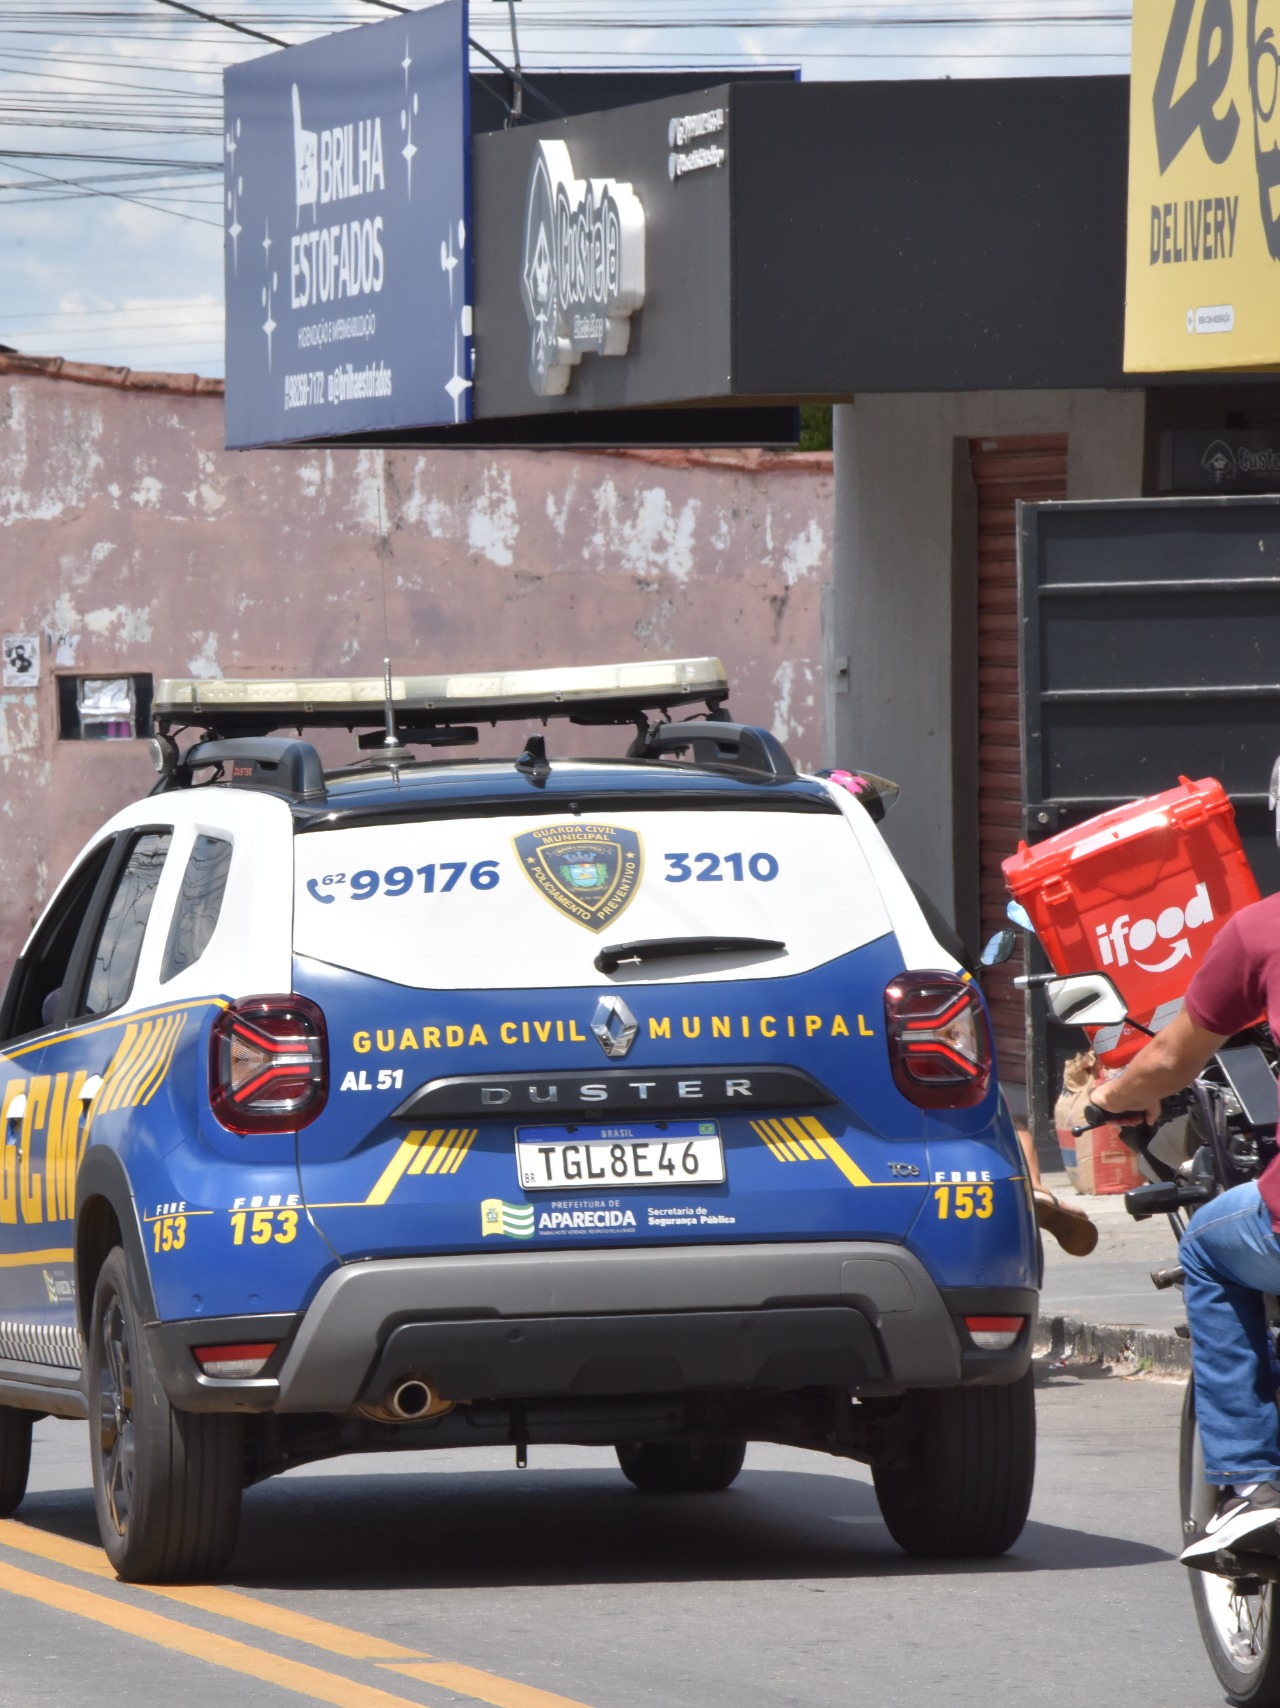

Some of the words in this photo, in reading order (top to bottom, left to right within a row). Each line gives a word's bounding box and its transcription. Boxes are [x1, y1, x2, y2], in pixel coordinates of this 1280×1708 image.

[321, 117, 385, 204] BRILHA
[1150, 195, 1239, 266] DELIVERY
[291, 216, 384, 309] ESTOFADOS
[532, 826, 582, 838] GUARDA
[585, 826, 616, 835] CIVIL
[542, 833, 610, 844] MUNICIPAL
[321, 873, 346, 885] 62
[349, 860, 500, 901] 99176
[664, 851, 779, 884] 3210
[531, 866, 591, 920] POLICIAMENTO
[597, 861, 636, 920] PREVENTIVO
[1095, 882, 1214, 967] ifood
[353, 1024, 488, 1054] GUARDA
[500, 1019, 587, 1044] CIVIL
[648, 1014, 874, 1039] MUNICIPAL
[340, 1070, 374, 1092] AL
[376, 1068, 404, 1090] 51
[481, 1078, 753, 1105] DUSTER
[601, 1129, 634, 1138] BRASIL
[538, 1142, 699, 1181] TGL8E46
[888, 1162, 920, 1177] TCe
[524, 1173, 536, 1183] BR
[935, 1171, 991, 1182] FONE
[156, 1201, 186, 1216] FONE
[233, 1194, 299, 1210] FONE
[552, 1201, 605, 1209] PREFEITURA
[609, 1200, 620, 1208] DE
[647, 1207, 694, 1216] Secretaria
[695, 1207, 708, 1215] de
[934, 1185, 994, 1220] 153
[231, 1210, 299, 1245] 153
[538, 1210, 637, 1229] APARECIDA
[648, 1216, 697, 1227] Segurança
[700, 1215, 736, 1224] Pública
[153, 1216, 187, 1253] 153
